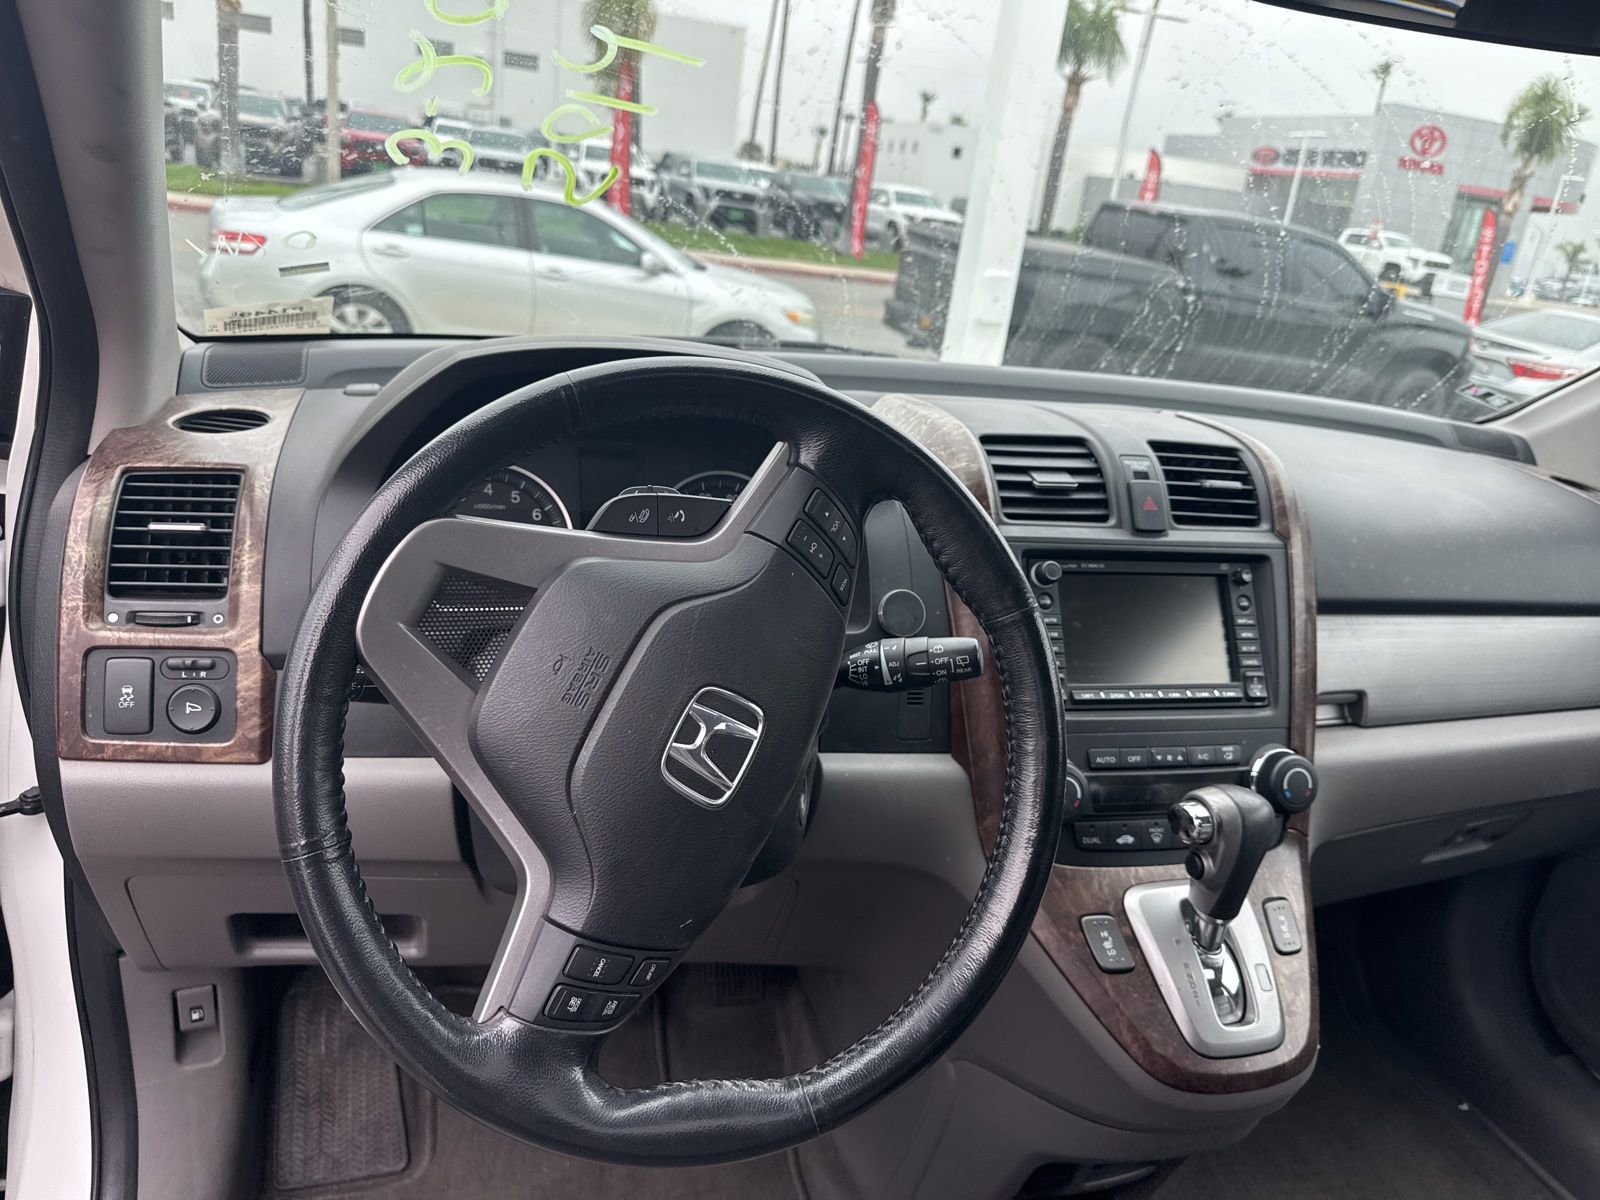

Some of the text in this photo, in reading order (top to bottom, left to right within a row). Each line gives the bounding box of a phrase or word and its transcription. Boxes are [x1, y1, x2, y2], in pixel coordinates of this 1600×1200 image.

[483, 483, 494, 496] 4
[511, 490, 521, 504] 5
[531, 508, 543, 521] 6
[830, 520, 841, 533] VOL
[808, 542, 818, 554] CH
[857, 658, 870, 666] OFF
[888, 660, 900, 668] ADJ
[934, 656, 949, 665] OFF
[561, 646, 596, 704] AIRBAG
[956, 666, 973, 674] REAR
[574, 653, 611, 710] SRS
[118, 701, 136, 709] OFF
[1095, 756, 1117, 764] AUTO
[1127, 755, 1141, 763] OFF
[1082, 836, 1102, 844] DUAL
[592, 958, 606, 978] CANCEL
[566, 996, 578, 1011] SET
